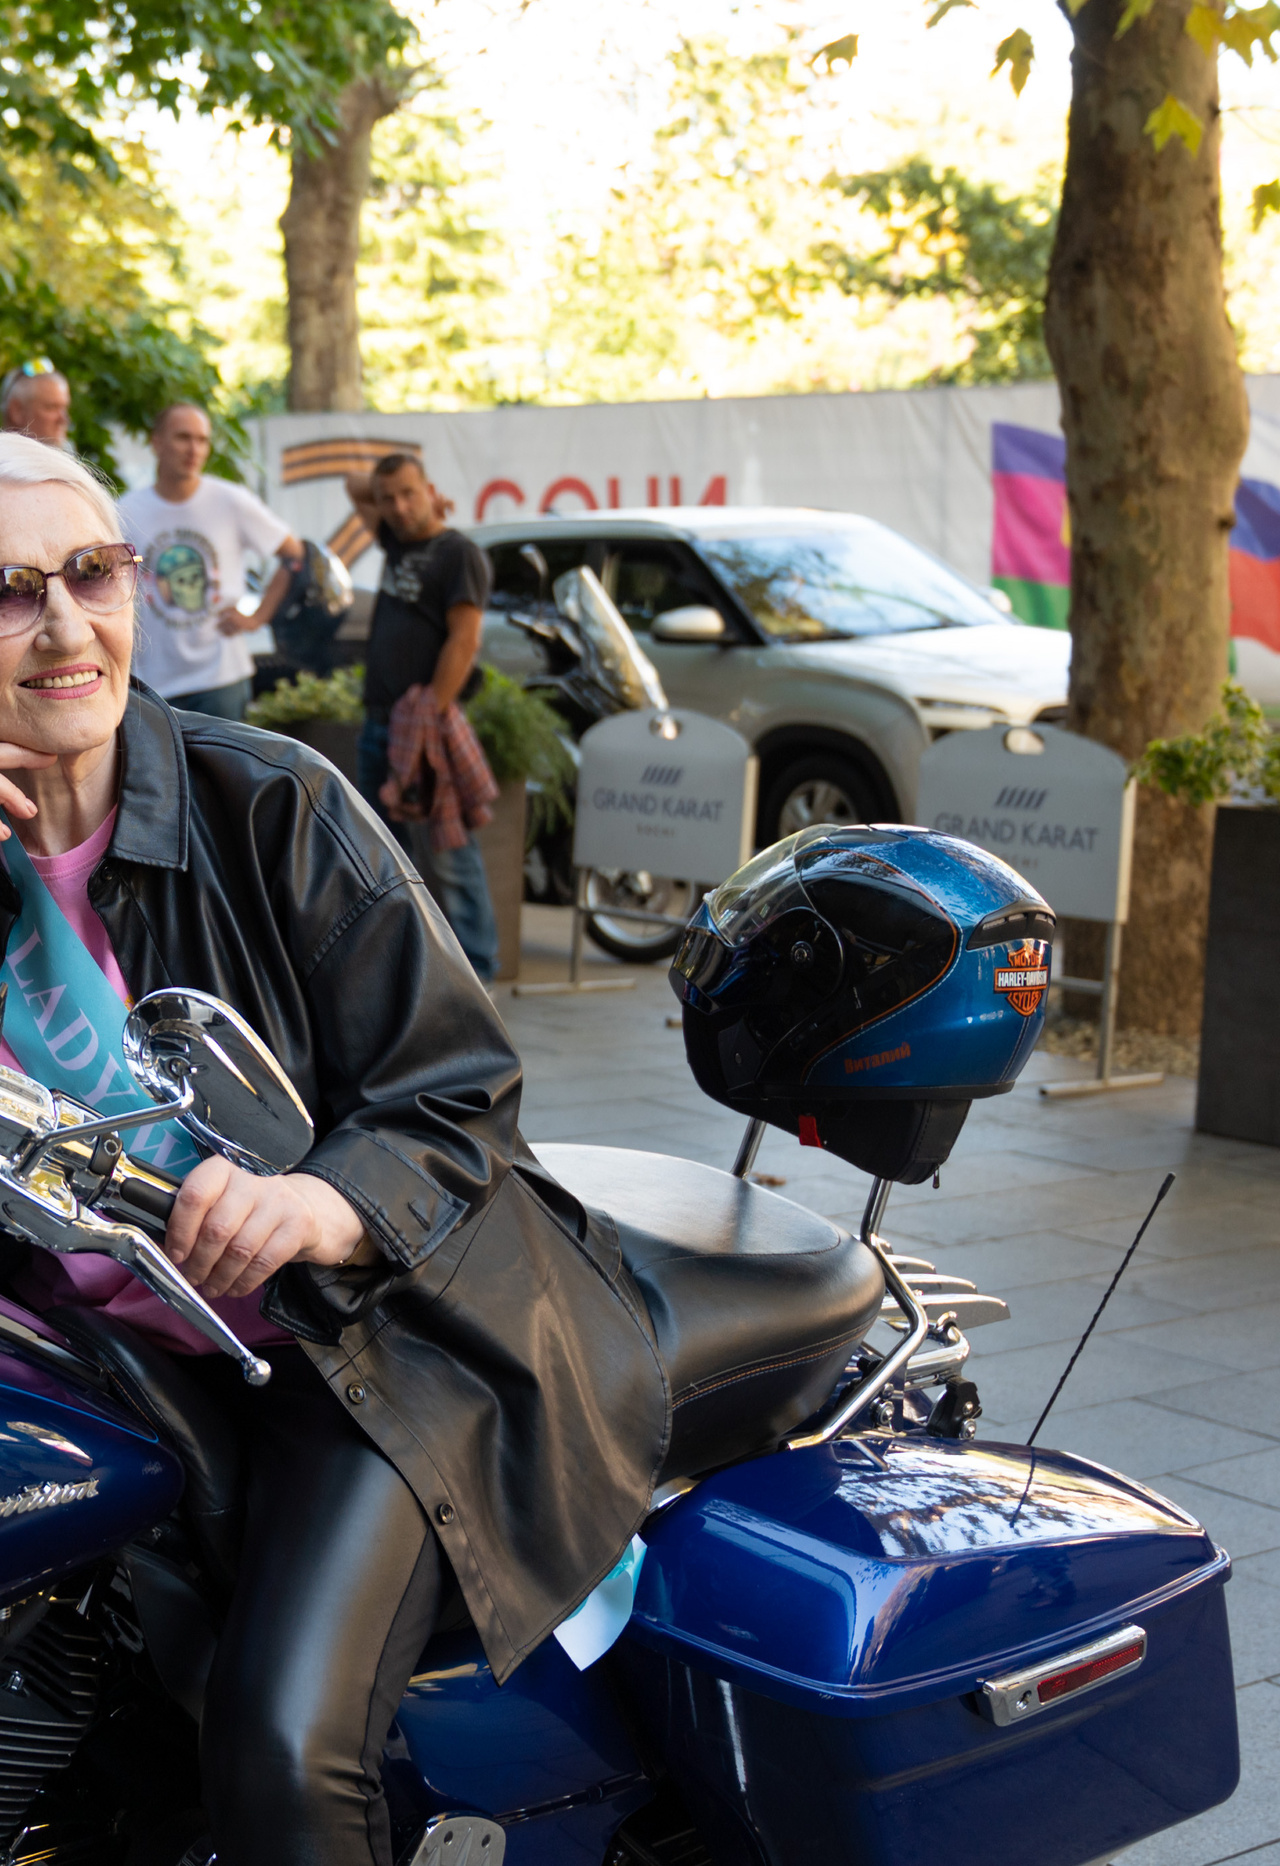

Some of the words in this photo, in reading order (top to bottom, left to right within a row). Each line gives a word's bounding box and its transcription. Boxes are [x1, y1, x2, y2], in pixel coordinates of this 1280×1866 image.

[593, 787, 657, 816] GRAND
[662, 796, 724, 821] KARAT
[934, 811, 1016, 844] GRAND
[1022, 820, 1099, 852] KARAT
[5, 924, 138, 1107] LADY
